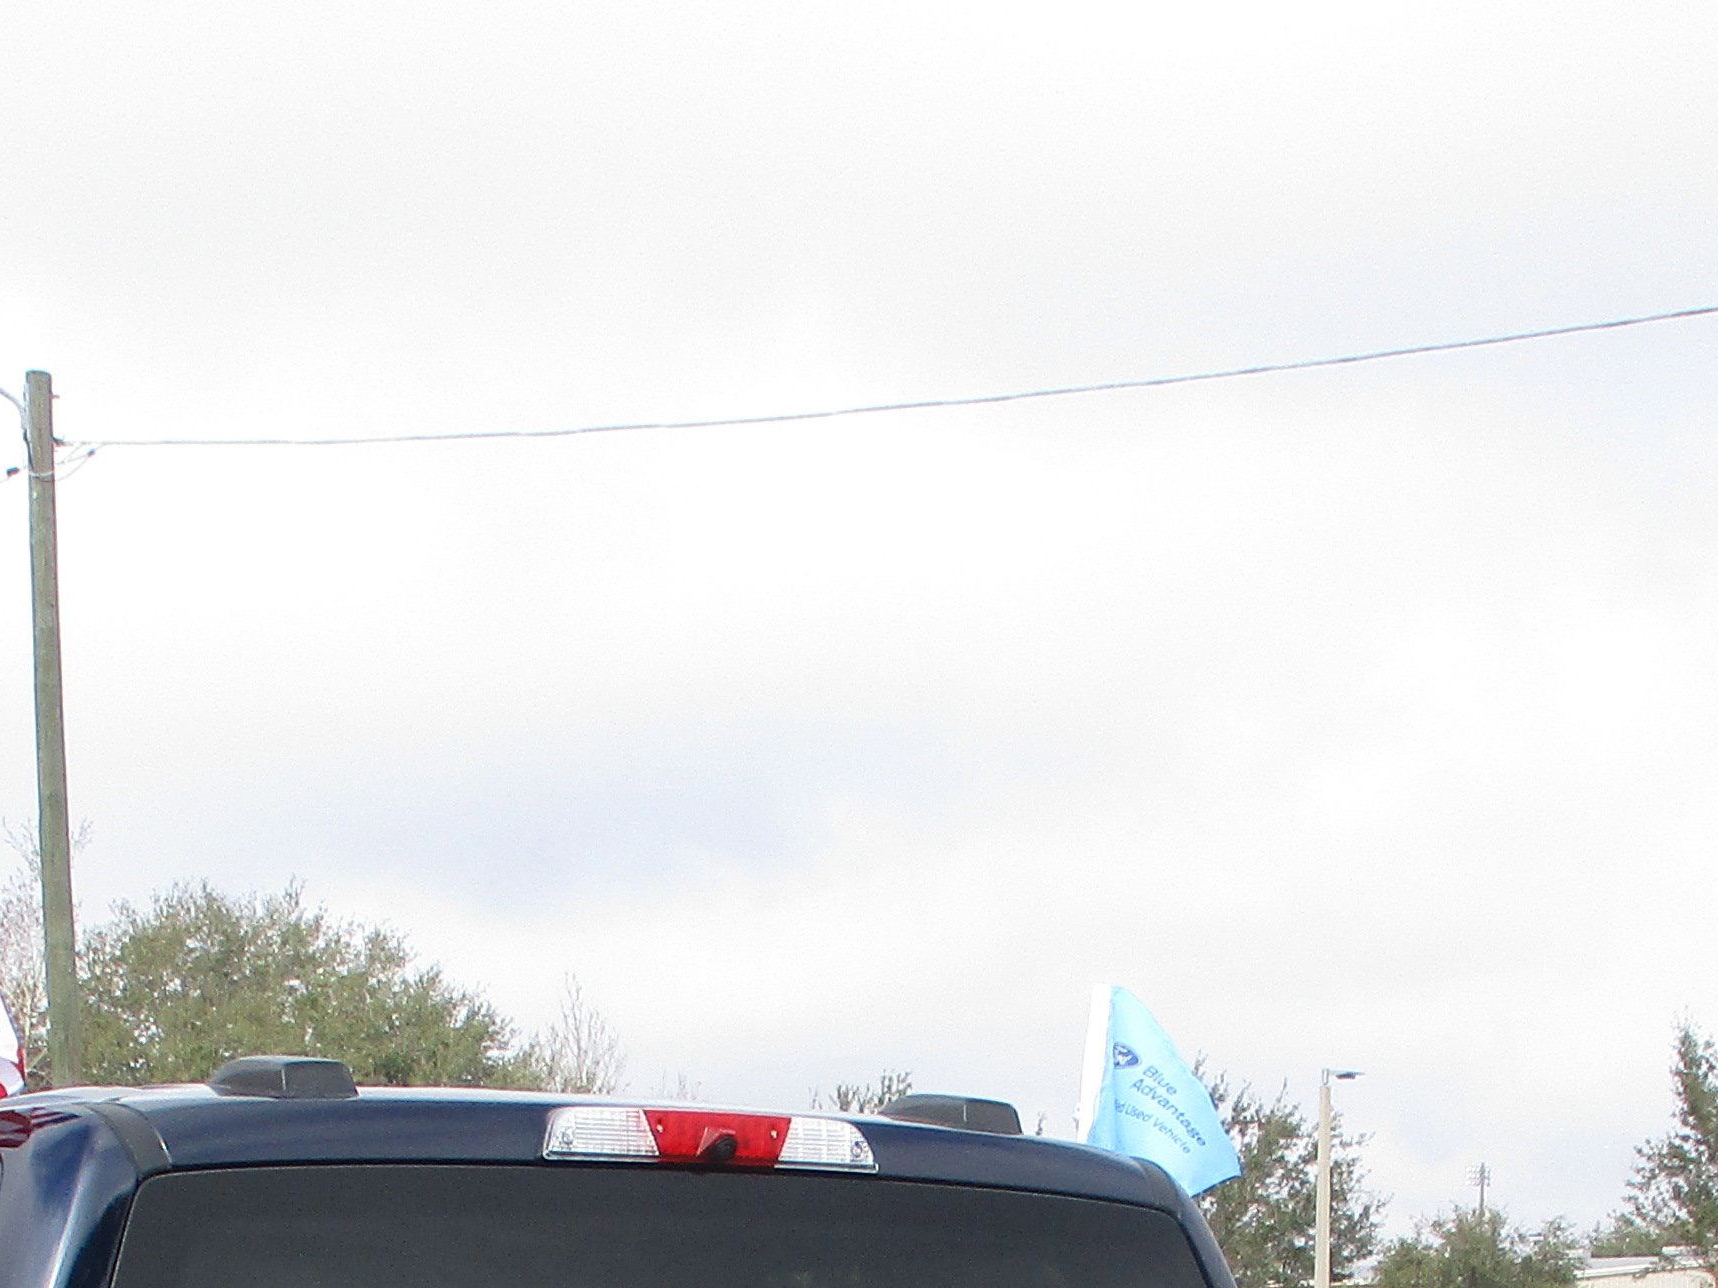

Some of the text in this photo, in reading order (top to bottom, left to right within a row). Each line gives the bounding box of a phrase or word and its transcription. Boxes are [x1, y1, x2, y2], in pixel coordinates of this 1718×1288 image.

[1143, 1065, 1177, 1096] Blue
[1125, 1103, 1154, 1122] Used
[1153, 1117, 1191, 1154] Vehicle
[1131, 1078, 1206, 1146] Advantage
